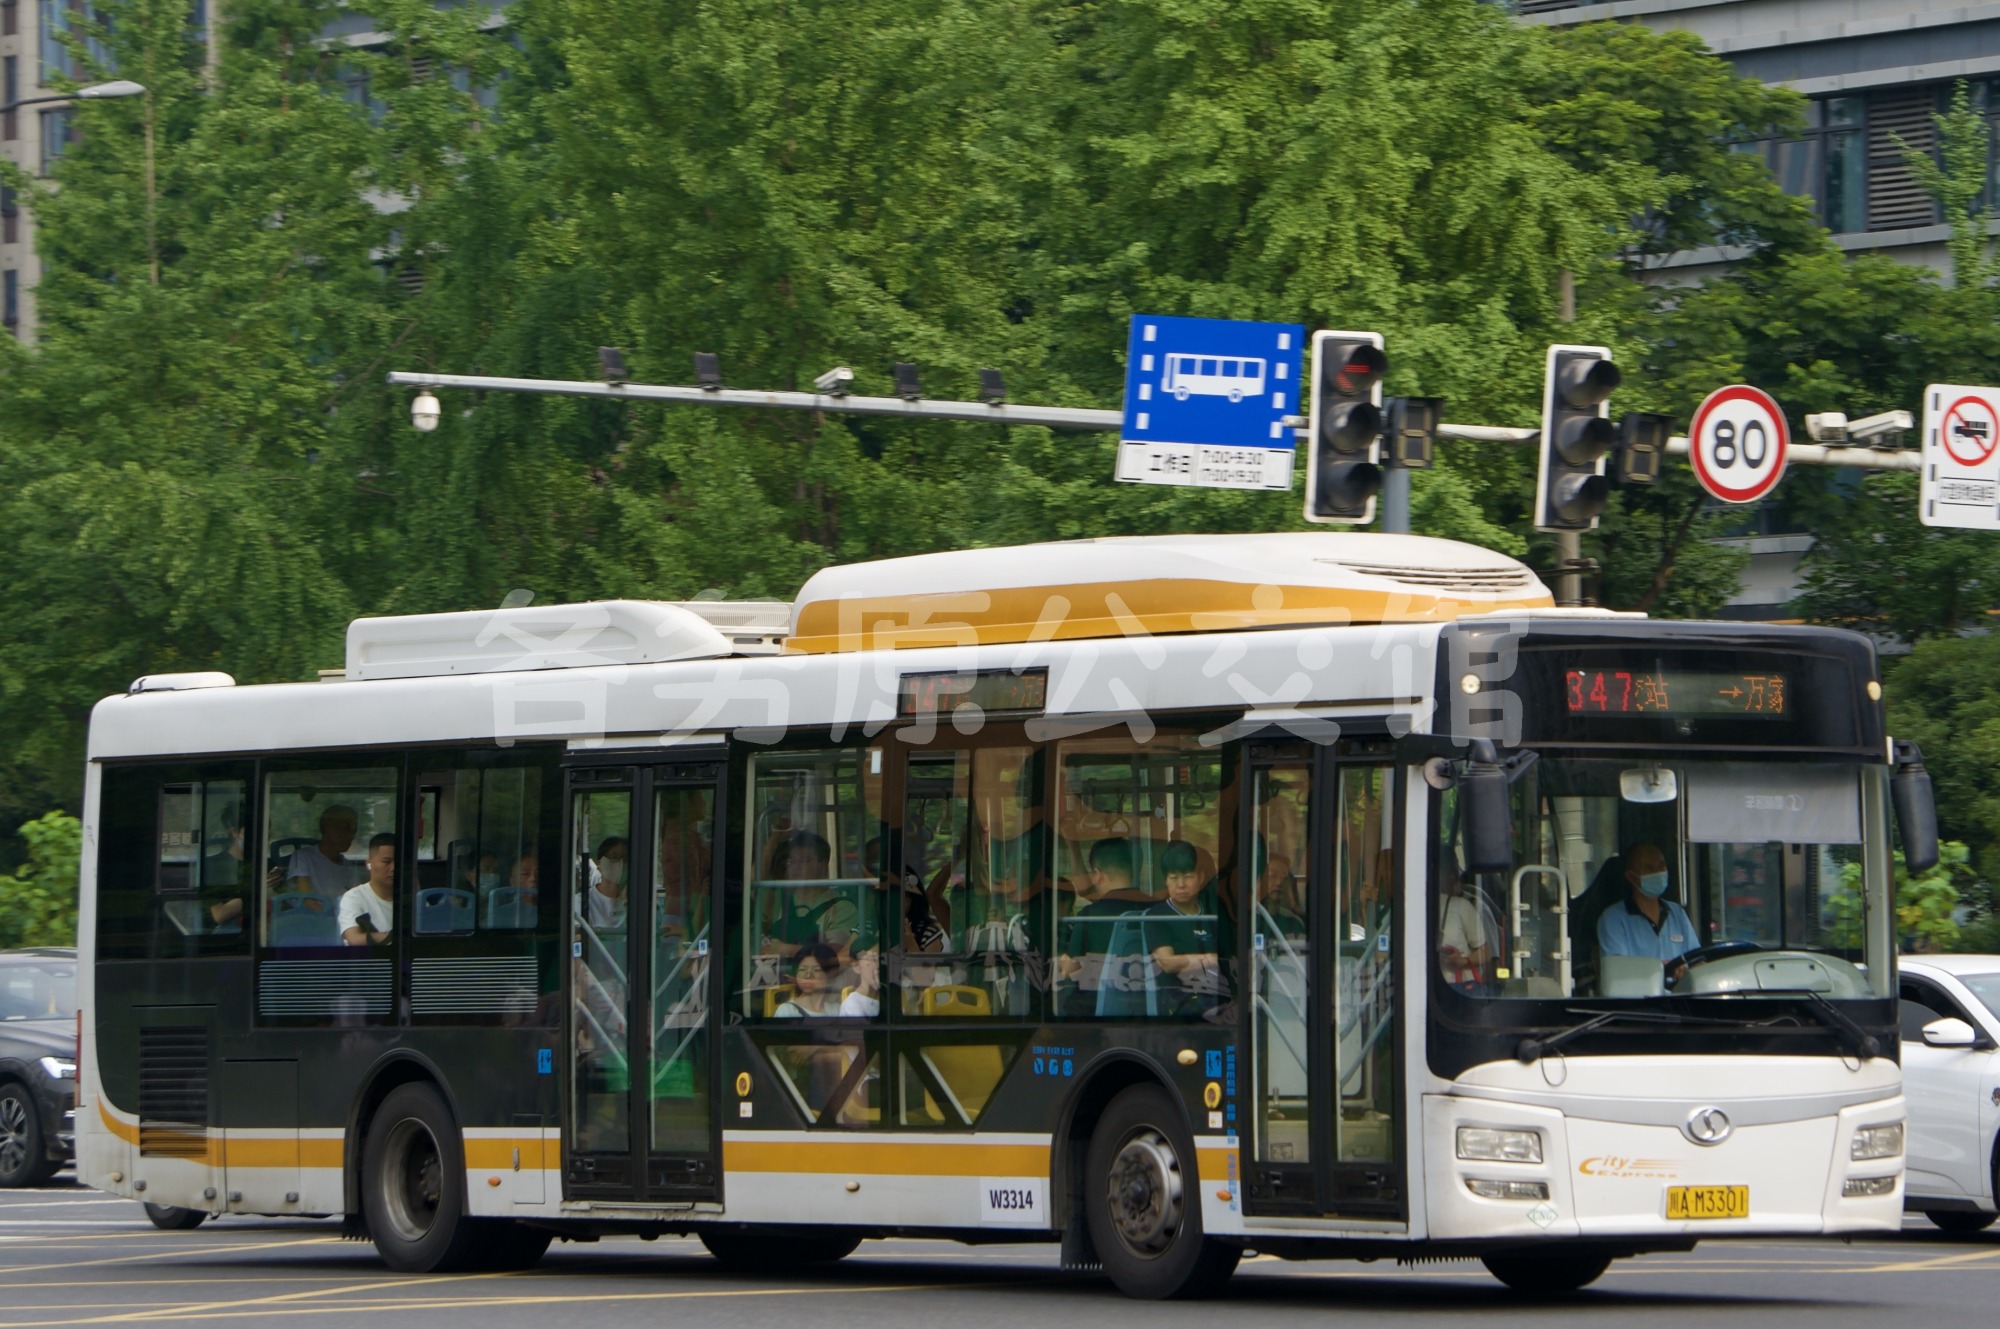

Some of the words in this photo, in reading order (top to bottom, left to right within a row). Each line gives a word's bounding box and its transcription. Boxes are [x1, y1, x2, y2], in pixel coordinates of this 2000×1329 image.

[1713, 419, 1767, 470] 80
[1566, 671, 1632, 712] 347
[989, 1189, 1034, 1210] W3314
